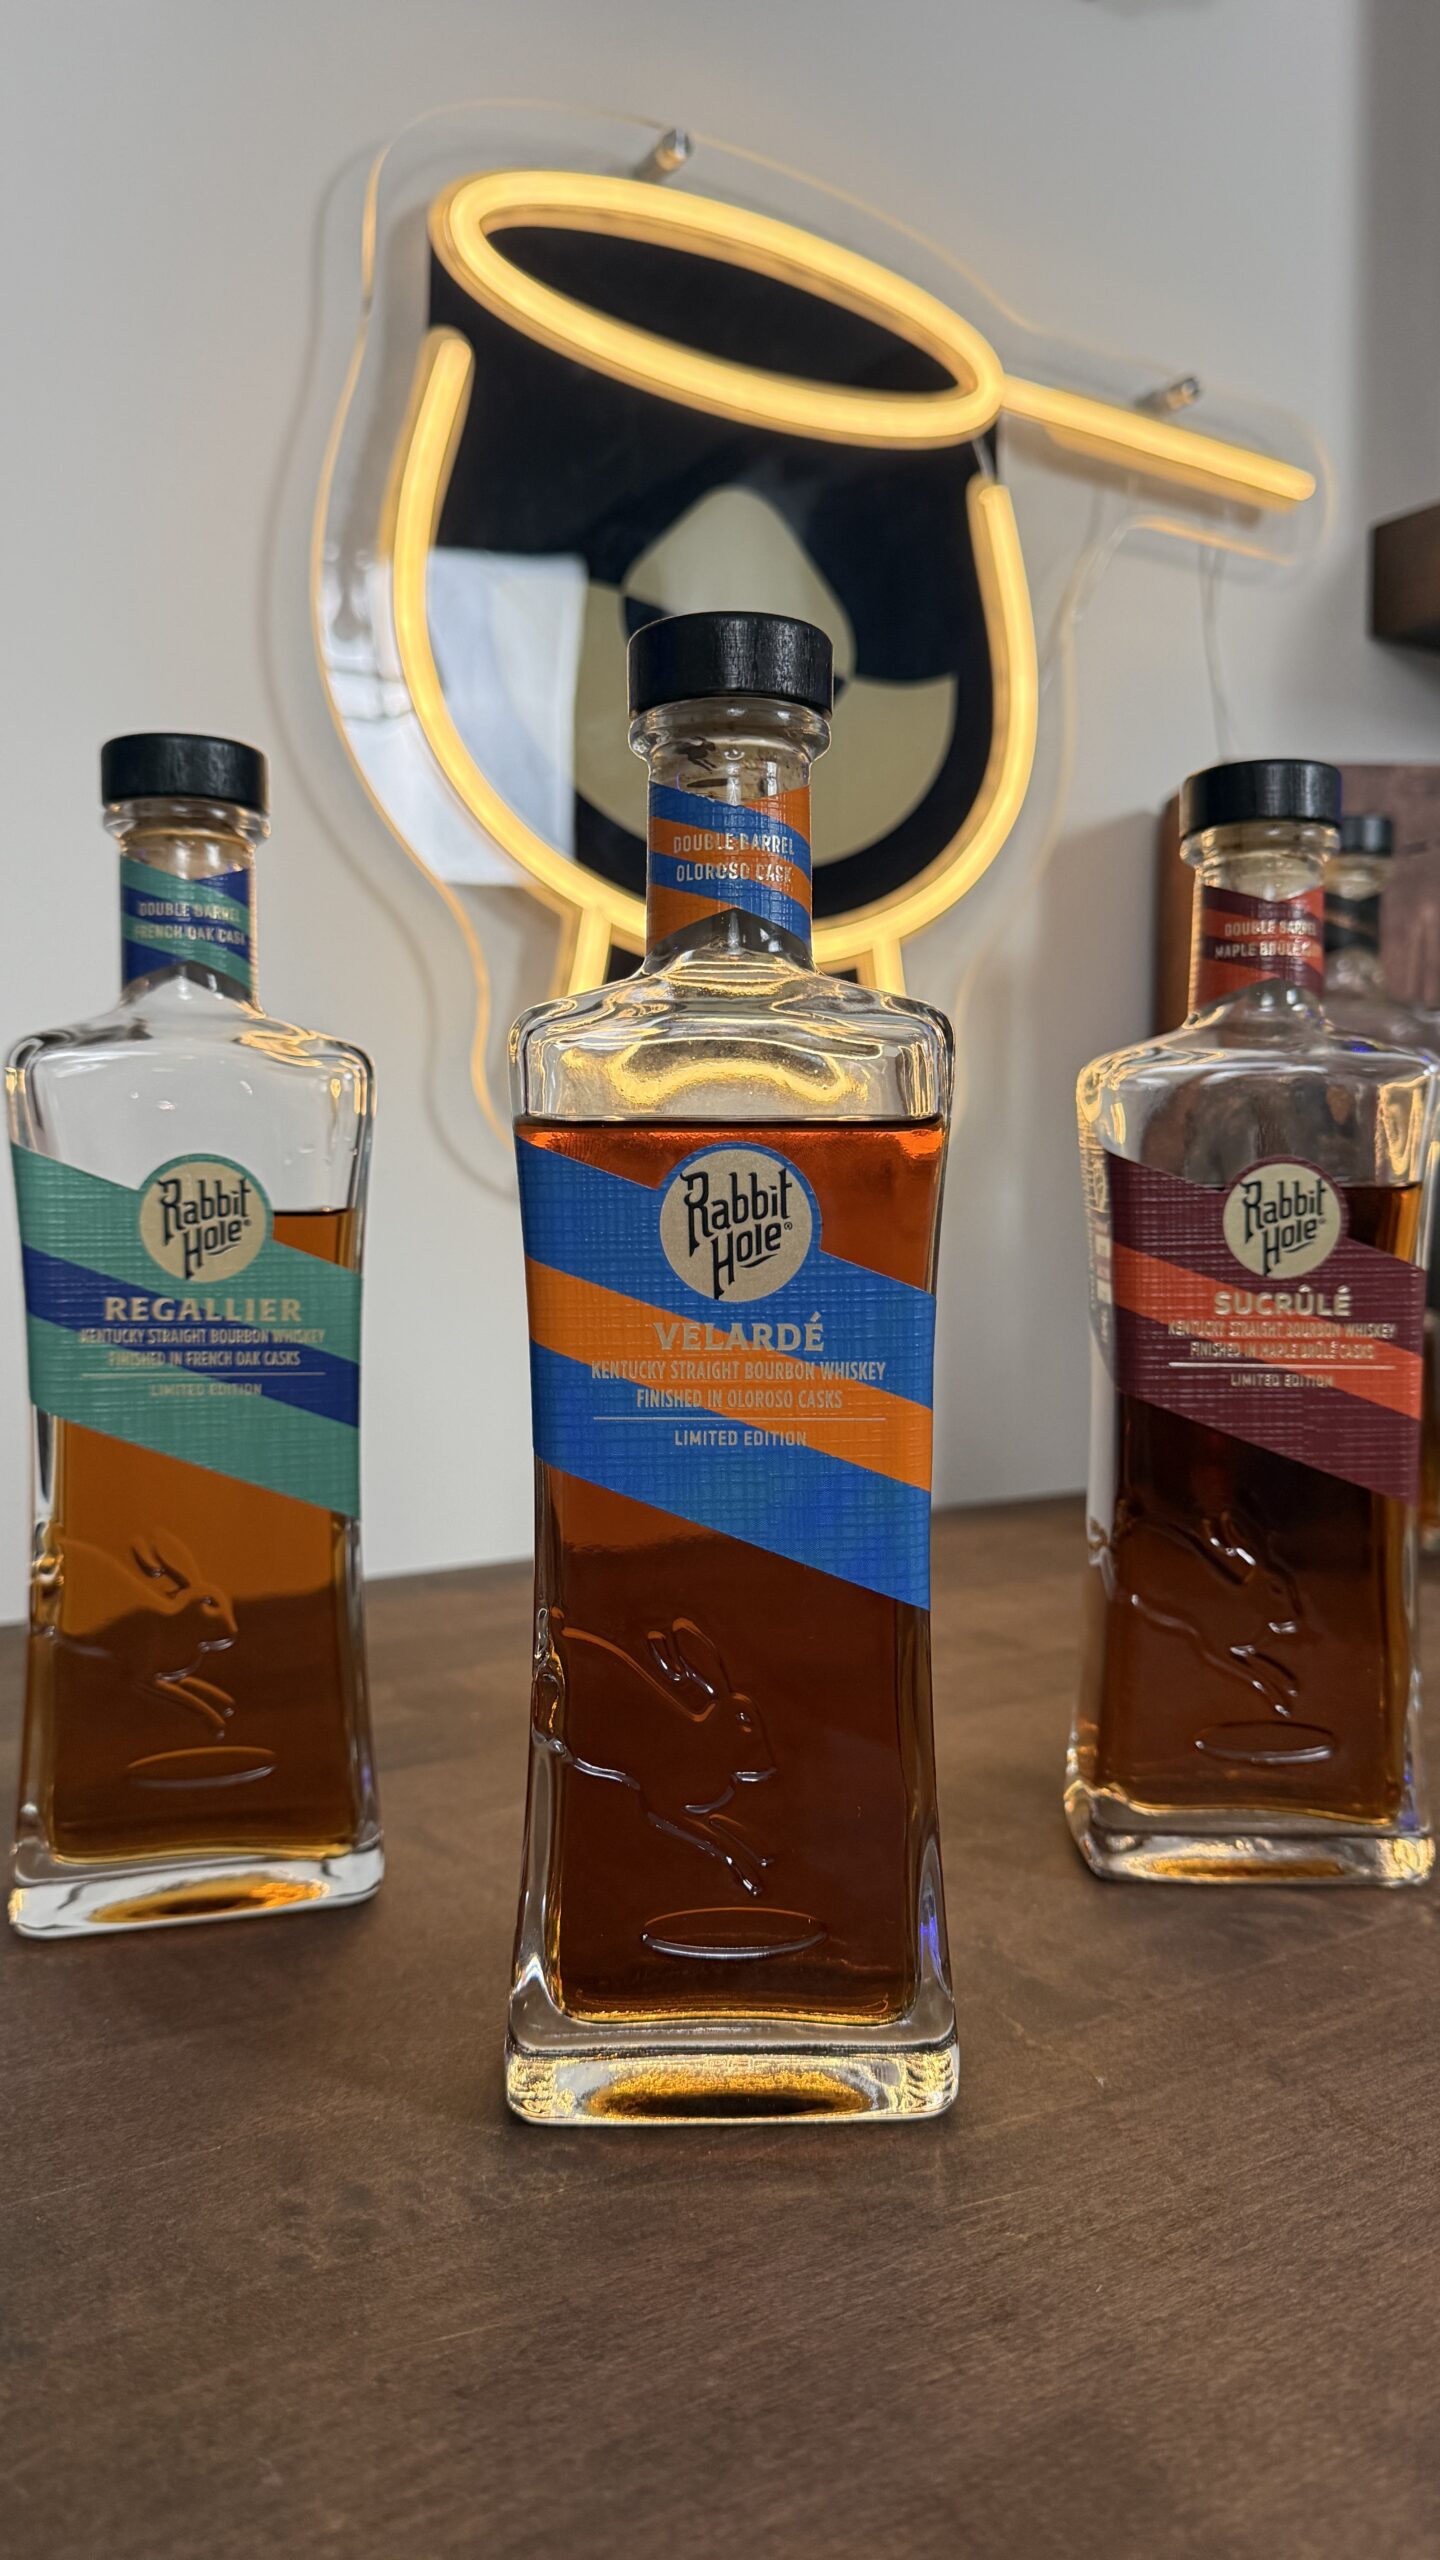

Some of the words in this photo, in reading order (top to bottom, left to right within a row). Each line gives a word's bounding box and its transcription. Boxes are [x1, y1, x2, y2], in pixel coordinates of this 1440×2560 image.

[673, 832, 734, 854] DOUBLE
[740, 832, 795, 856] BARREL
[676, 862, 750, 882] OLOROSO
[755, 862, 793, 883] CASK
[138, 901, 191, 917] DOUBLE
[187, 925, 216, 942] OAK
[1224, 919, 1277, 936] DOUBLE
[1214, 941, 1257, 960] MAPLE
[157, 1176, 252, 1246] Rabbit
[680, 1167, 793, 1257] Rabbit
[1239, 1178, 1327, 1244] Rabbit
[104, 1297, 302, 1323] REGALLIER
[79, 1328, 144, 1345] KENTUCKY
[147, 1328, 206, 1344] STRAIGHT
[210, 1327, 269, 1344] BOURBON
[272, 1328, 326, 1344] WHISKEY
[653, 1311, 824, 1352] VELARDÉ
[1168, 1320, 1225, 1337] KENTUCKY
[1229, 1321, 1284, 1338] STRAIGHT
[1287, 1321, 1343, 1338] BOURBON
[1344, 1323, 1397, 1339] WHISKEY
[109, 1350, 165, 1367] FINISHED
[168, 1350, 183, 1366] IN
[185, 1350, 234, 1366] FRENCH
[236, 1350, 262, 1366] OAK
[263, 1350, 301, 1366] CASKS
[1190, 1341, 1241, 1358] FINISHED
[1244, 1343, 1257, 1358] IN
[591, 1361, 665, 1380] KENTUCKY
[670, 1361, 741, 1380] STRAIGHT
[744, 1361, 815, 1380] BOURBON
[820, 1362, 887, 1382] WHISKEY
[1230, 1373, 1280, 1388] LIMITED
[1284, 1374, 1334, 1389] EDITION
[151, 1383, 205, 1397] LIMITED
[208, 1383, 263, 1397] EDITION
[636, 1388, 702, 1409] FINISHED
[707, 1389, 723, 1409] IN
[727, 1389, 794, 1409] OLOROSO
[798, 1389, 843, 1409] CASKS
[674, 1430, 738, 1447] LIMITED
[744, 1430, 807, 1448] EDITION
